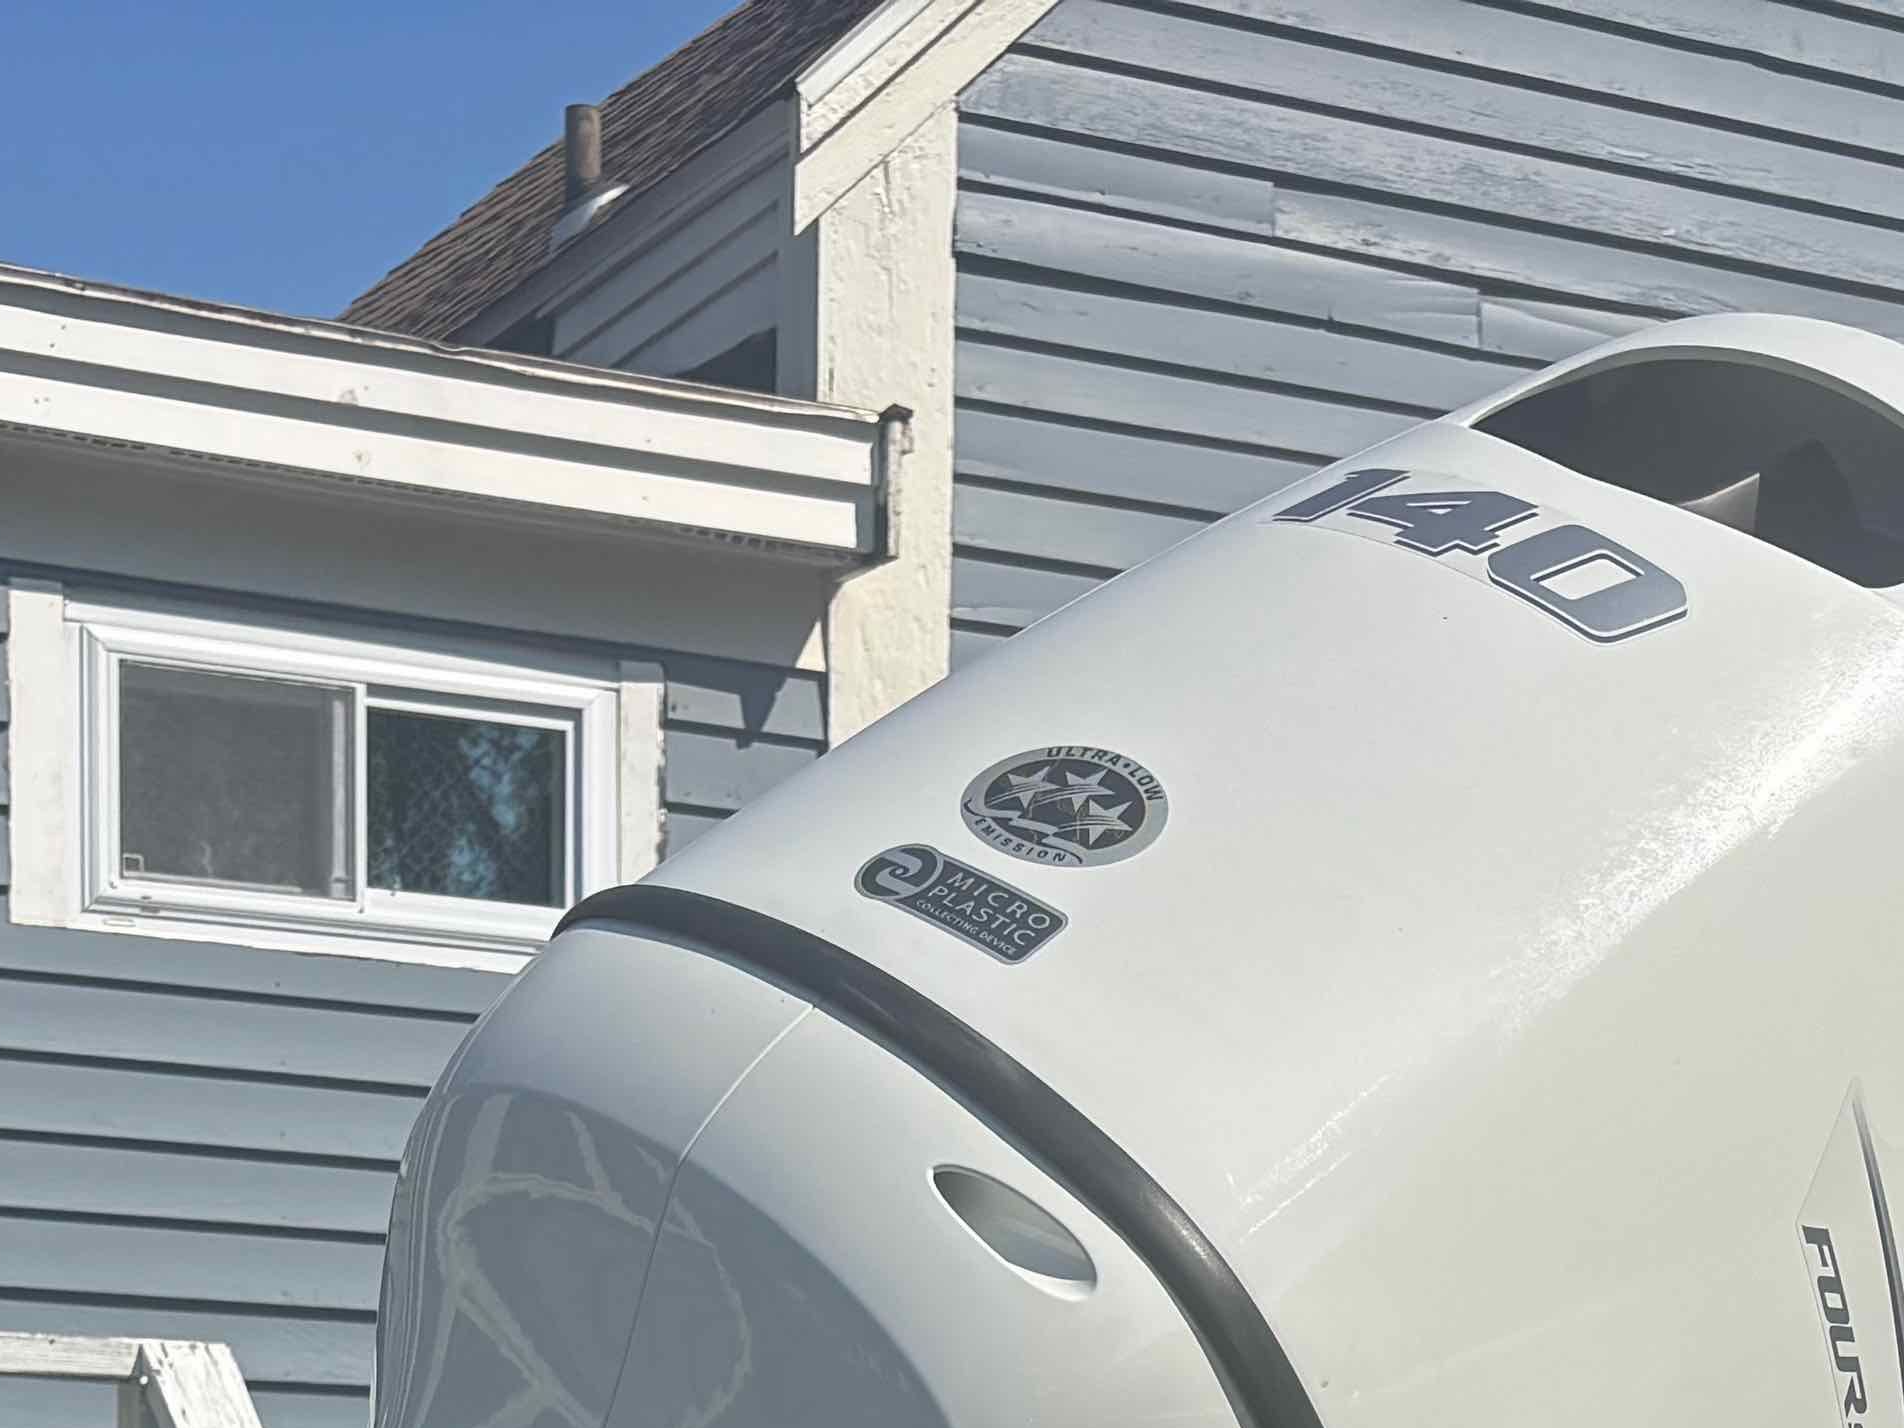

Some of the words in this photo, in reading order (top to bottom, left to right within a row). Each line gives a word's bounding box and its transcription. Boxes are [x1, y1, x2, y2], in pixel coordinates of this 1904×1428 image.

[1272, 468, 1687, 643] 140
[973, 817, 1067, 863] EMISSION
[916, 899, 978, 937] COLLECTING
[979, 931, 1016, 954] DEVICE
[928, 886, 1036, 947] PLASTIC
[947, 872, 1050, 930] MICRO
